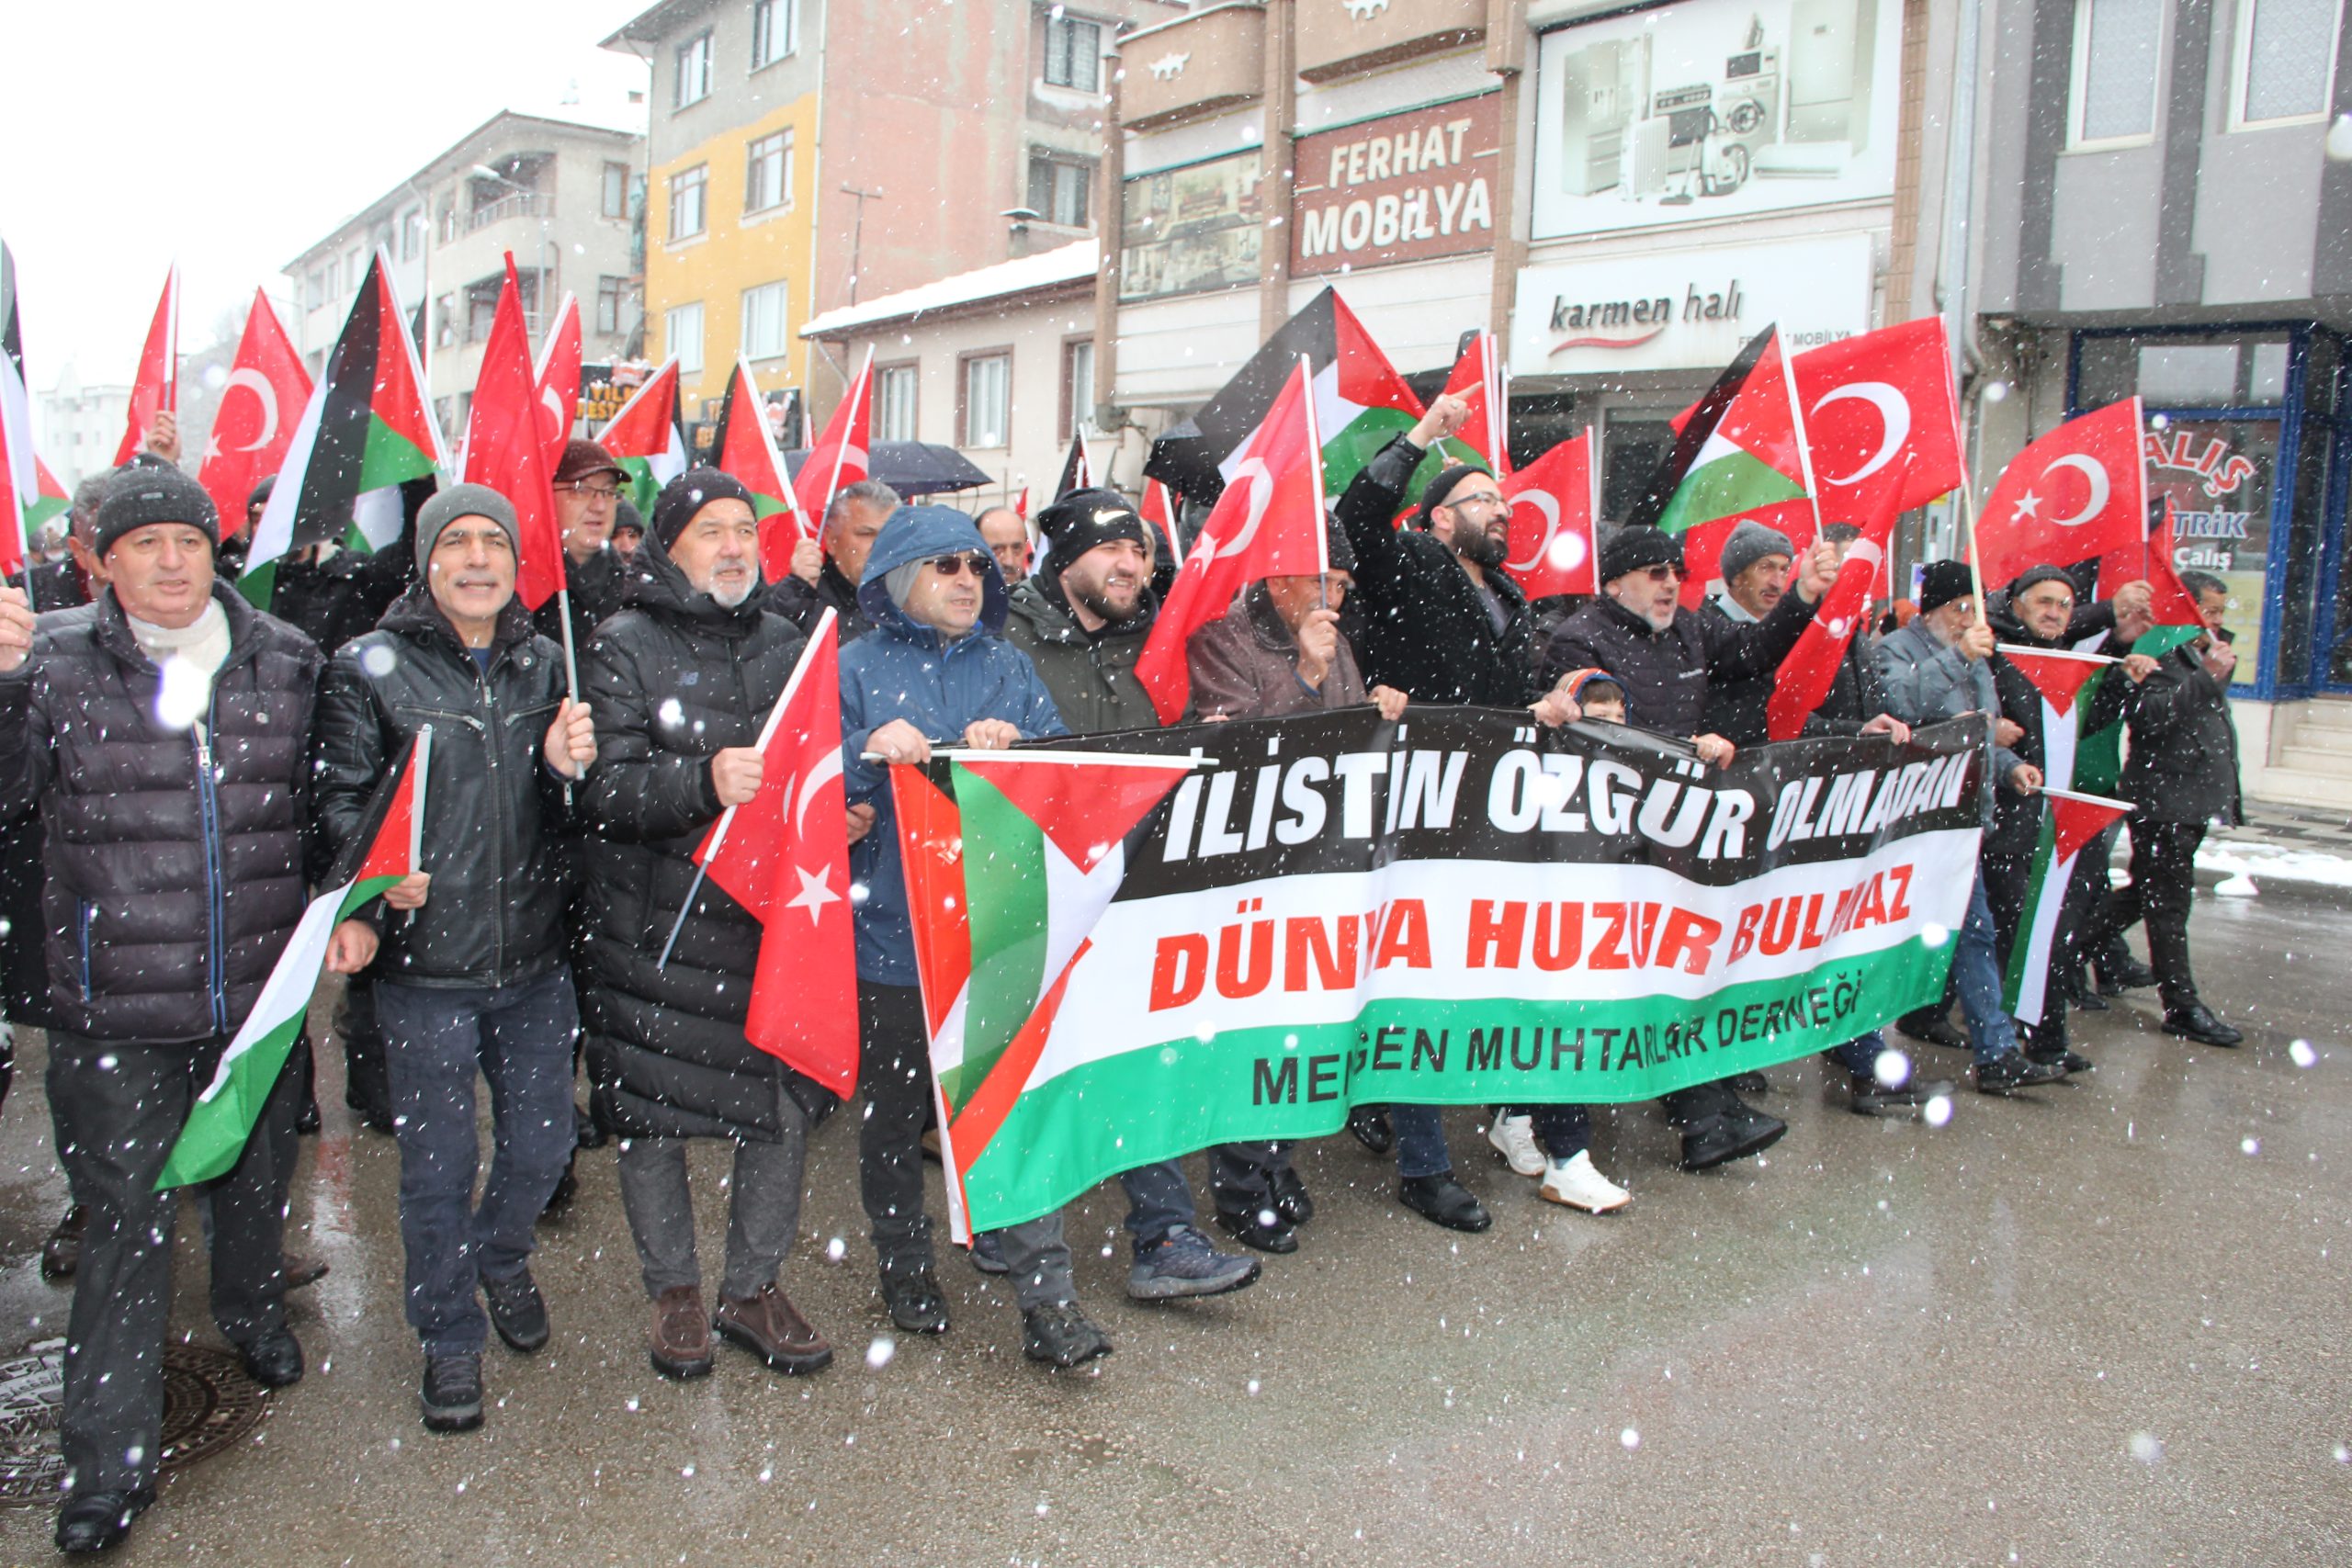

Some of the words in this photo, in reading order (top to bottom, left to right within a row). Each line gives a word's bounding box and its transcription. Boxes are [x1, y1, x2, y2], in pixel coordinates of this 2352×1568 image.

[1329, 118, 1472, 188] FERHAT
[1301, 178, 1492, 256] MOBİLYA
[1549, 295, 1670, 331] karmen
[1682, 279, 1743, 321] halı
[2144, 431, 2255, 497] ALIŞ
[2172, 505, 2250, 538] TRİK
[2174, 547, 2233, 571] Çalış
[1162, 725, 1469, 863] İLİSTİN
[1487, 727, 1755, 859] ÖZGÜR
[1766, 749, 1974, 852] OLMADAN
[1148, 897, 1431, 1013] DÜNYA
[1465, 898, 1723, 975] HUZUR
[1726, 863, 1915, 966] BULMAZ
[1465, 1016, 1707, 1072] MUHTARLAR
[1718, 970, 1862, 1047] DERNEĞİ
